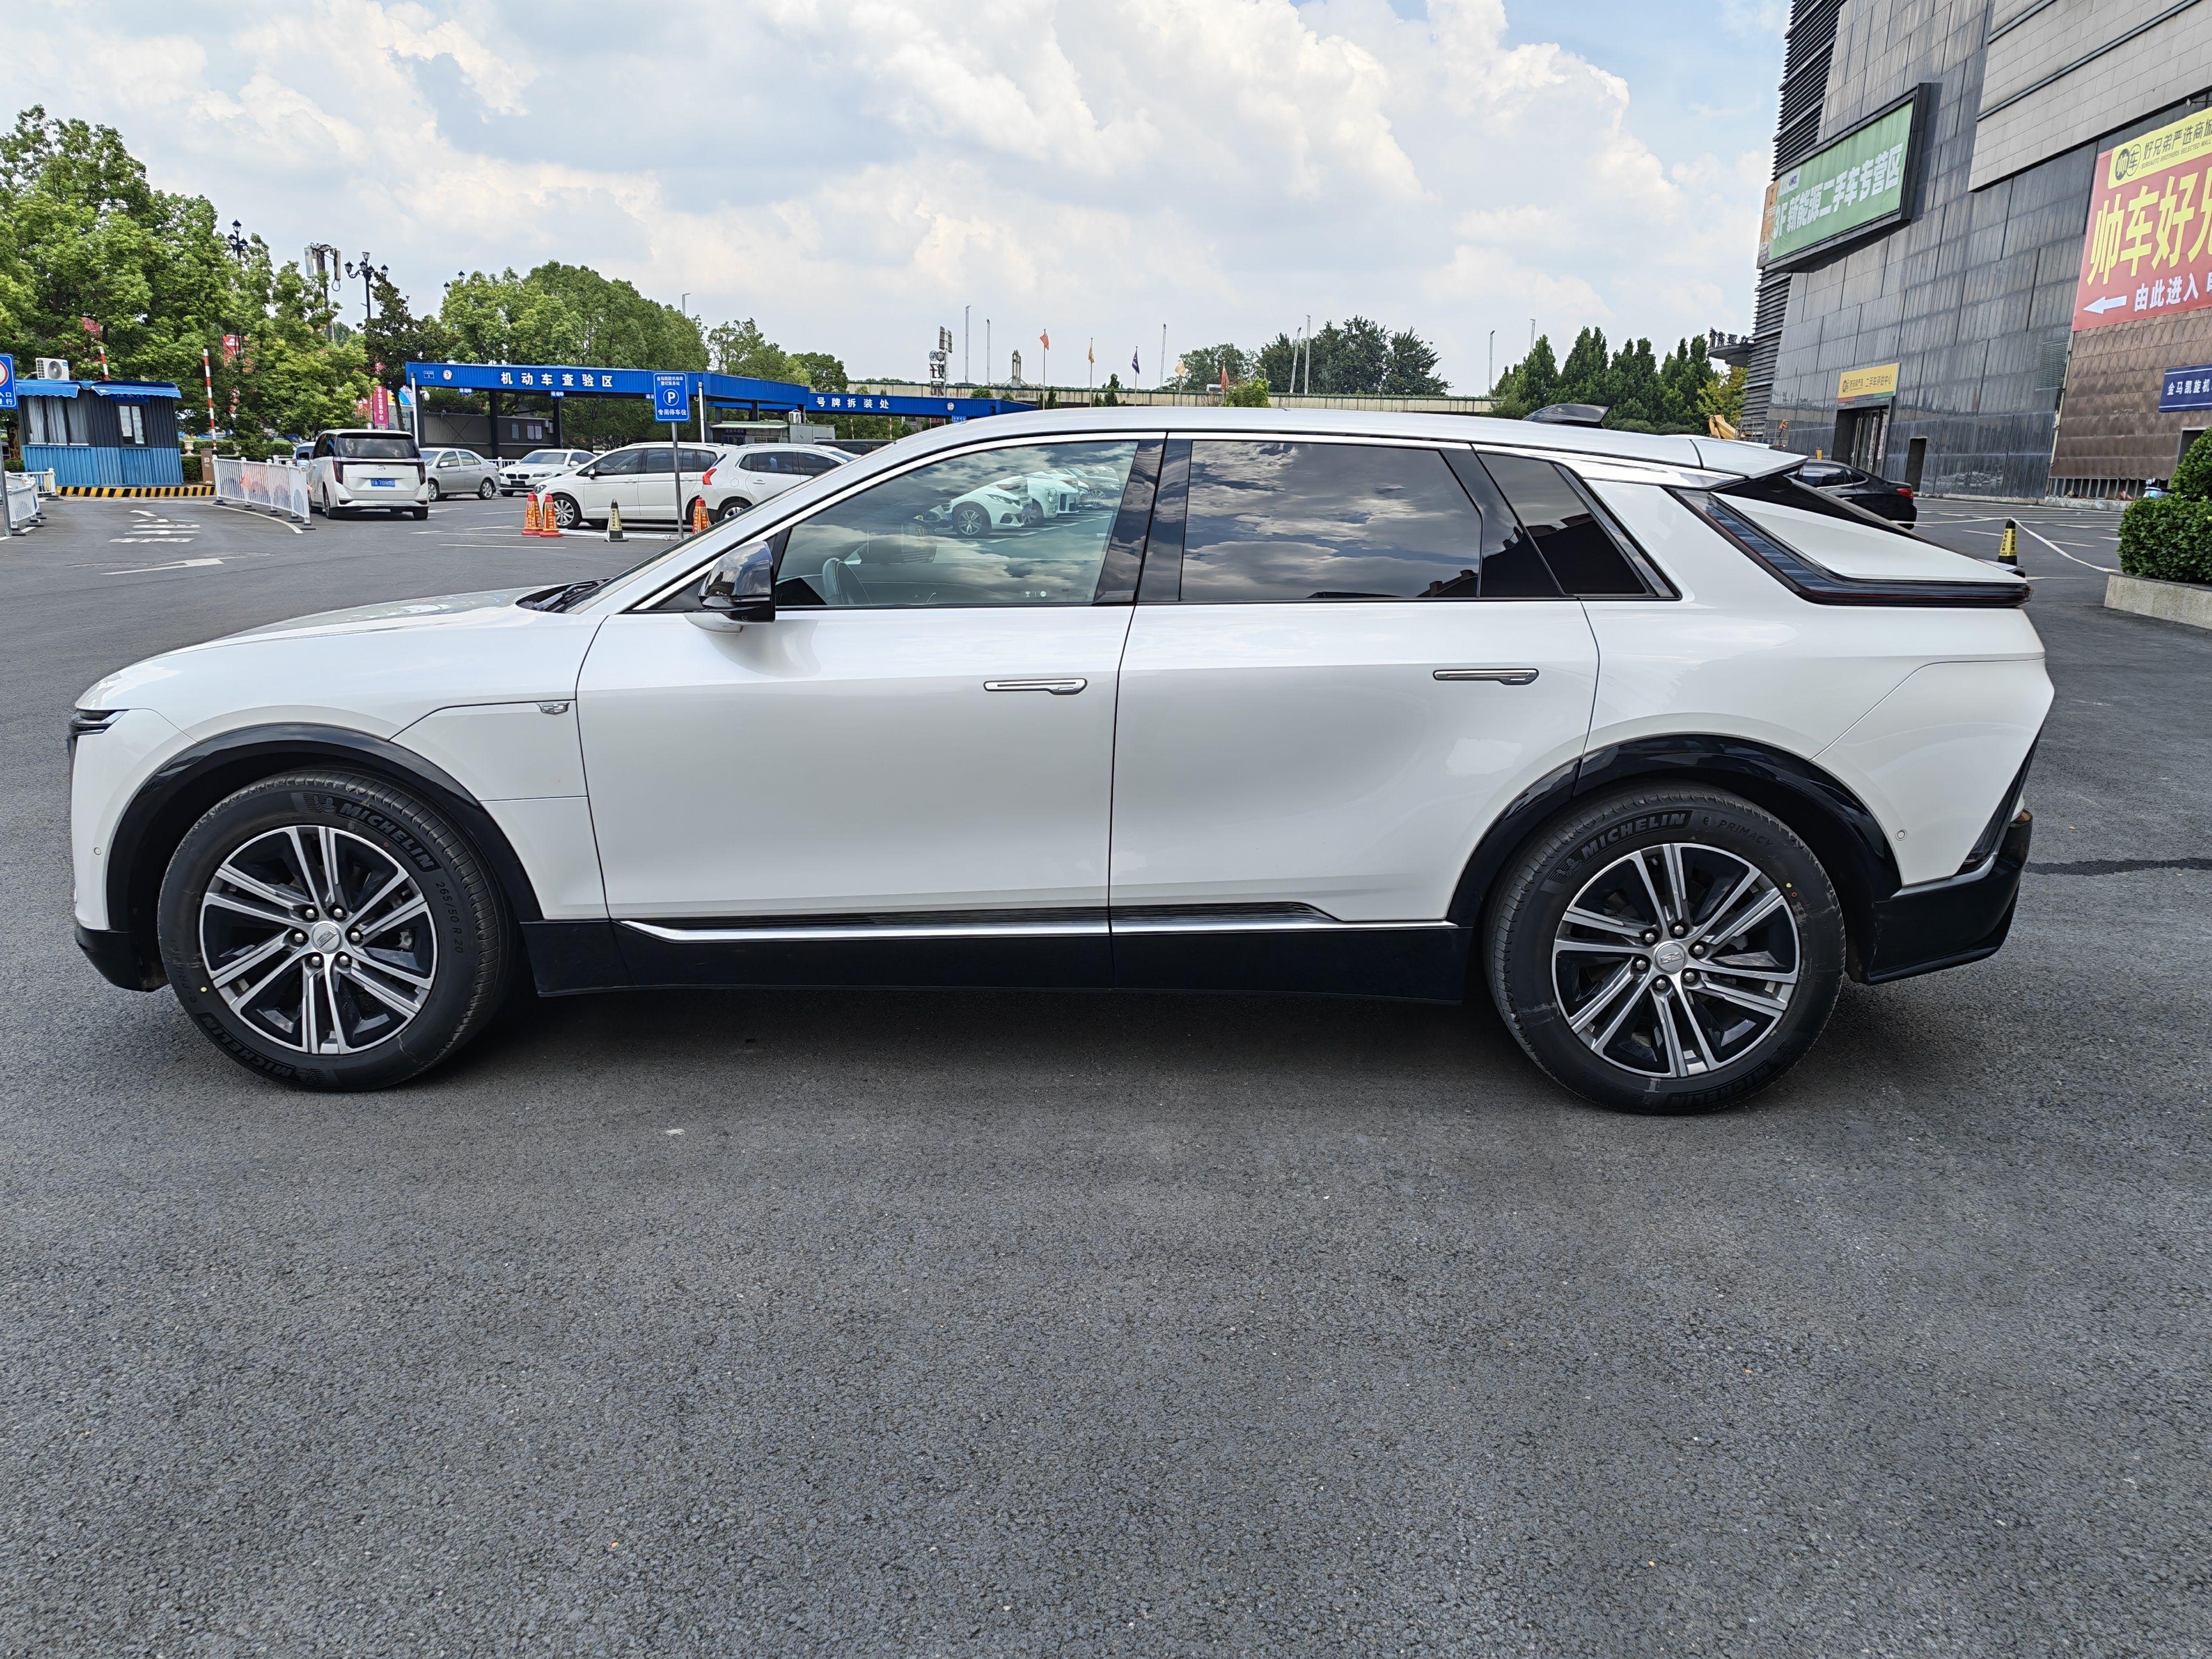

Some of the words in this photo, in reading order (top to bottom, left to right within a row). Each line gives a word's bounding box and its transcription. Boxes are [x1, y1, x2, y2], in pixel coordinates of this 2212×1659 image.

[2160, 150, 2180, 163] BROTHERS
[2180, 143, 2200, 156] SELECTED
[2201, 138, 2211, 147] MALL
[2134, 272, 2199, 312] 由此进入
[501, 372, 612, 387] 机动车查验区
[2167, 379, 2210, 395] 金马凯旋机
[667, 392, 676, 403] P
[816, 397, 889, 409] 号牌拆装处
[339, 803, 434, 868] MICHELIN
[1581, 812, 1687, 860] MICHELIN
[1717, 819, 1775, 848] PRIMACY
[435, 882, 458, 923] 265/50
[453, 927, 462, 935] R
[453, 939, 463, 954] 20
[200, 1015, 294, 1077] MICHELIN
[1670, 1064, 1772, 1107] MICHELIN
